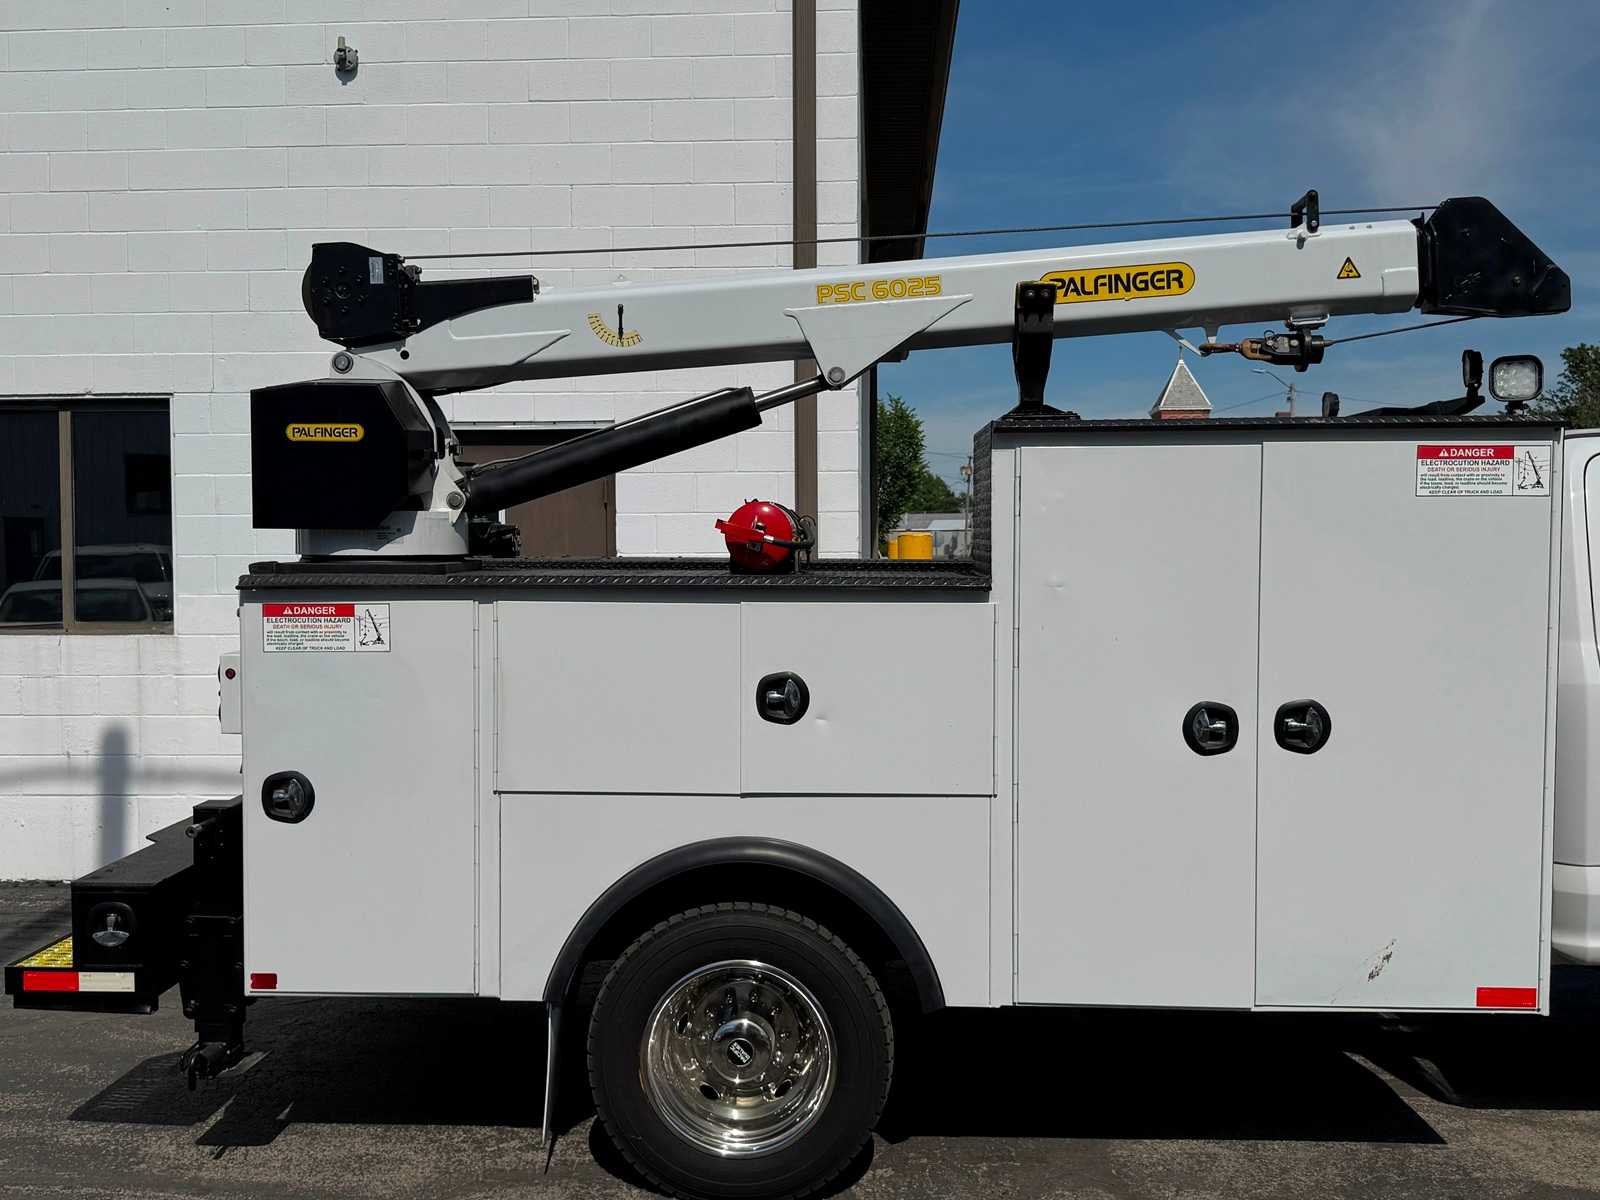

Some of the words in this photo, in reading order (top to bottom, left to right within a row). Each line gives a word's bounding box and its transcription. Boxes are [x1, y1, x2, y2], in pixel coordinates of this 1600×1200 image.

[1050, 269, 1184, 297] PALFINGER
[816, 282, 866, 304] PSC
[872, 275, 942, 300] 6025
[292, 427, 358, 438] PALFINGER
[1450, 448, 1495, 457] DANGER
[293, 606, 336, 615] DANGER
